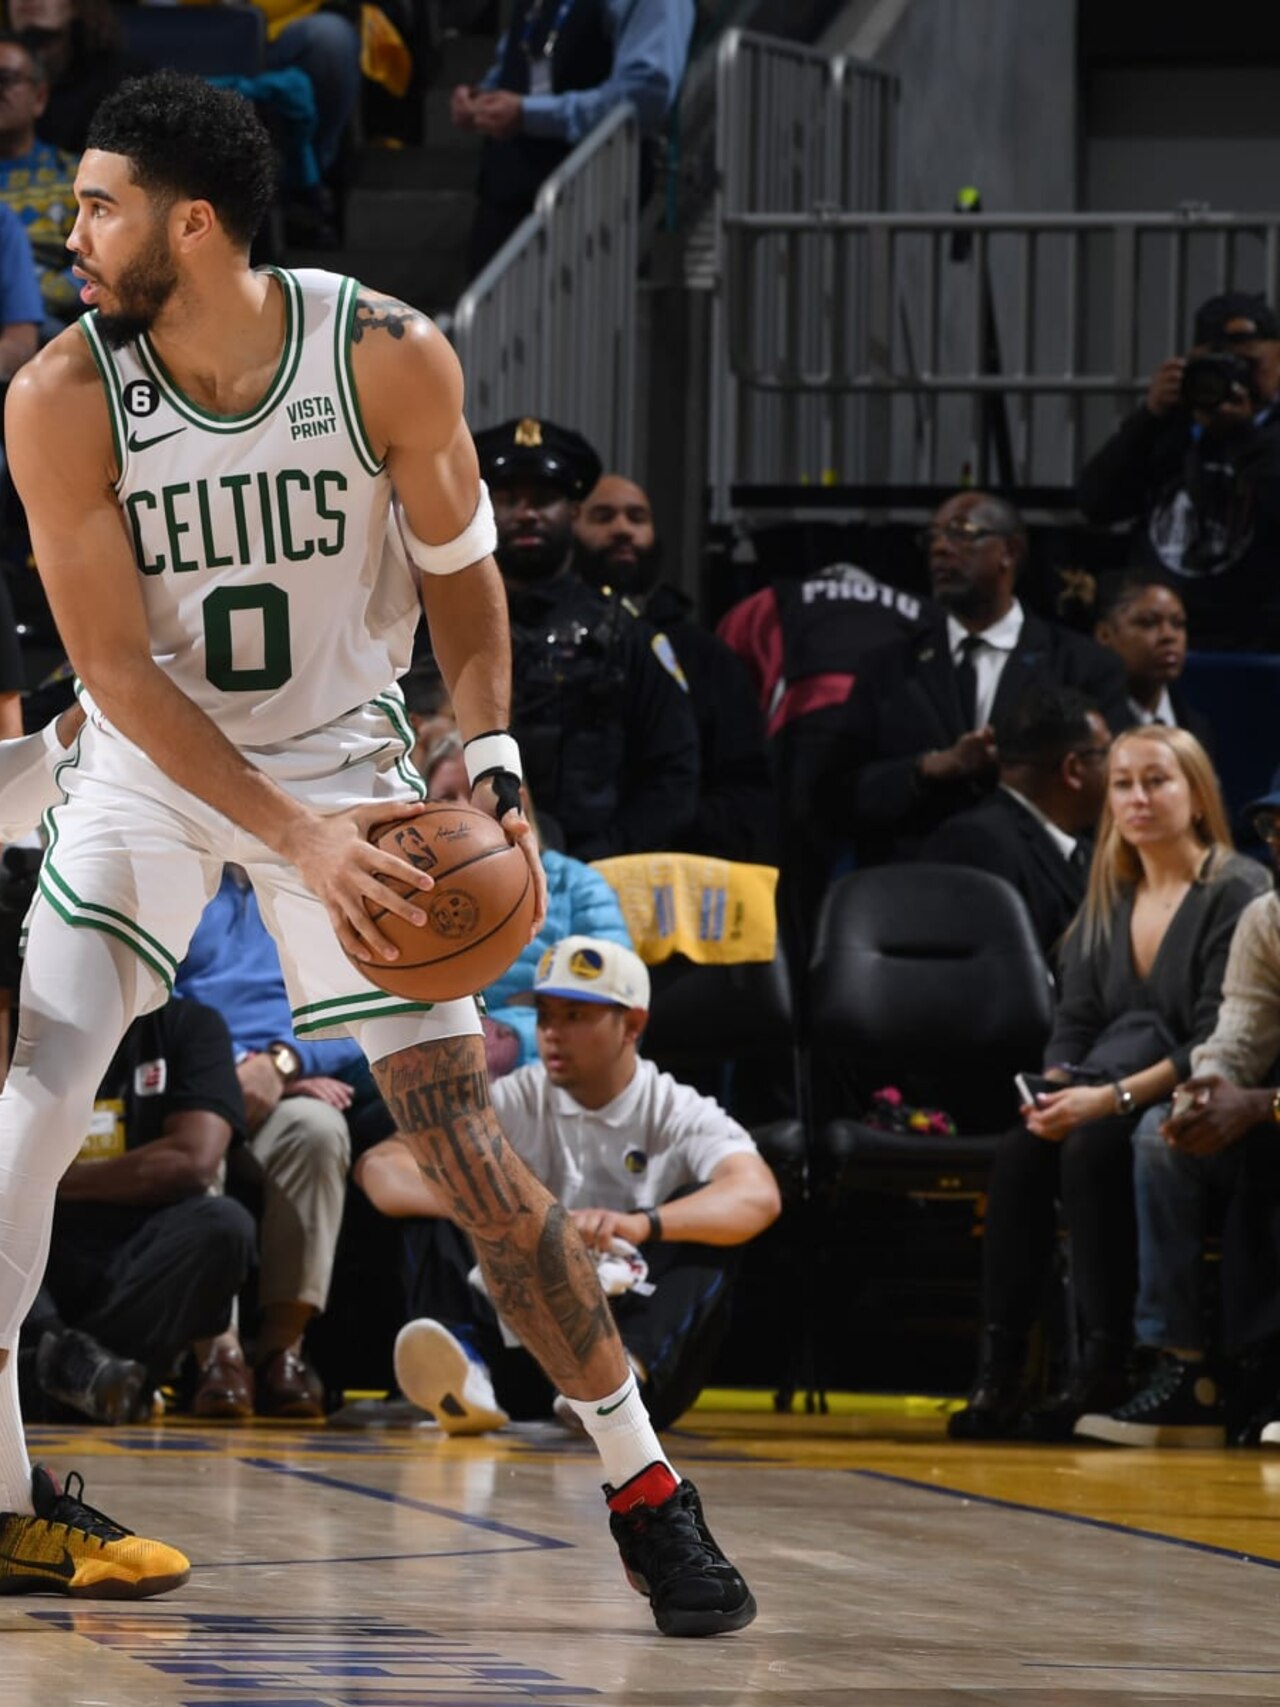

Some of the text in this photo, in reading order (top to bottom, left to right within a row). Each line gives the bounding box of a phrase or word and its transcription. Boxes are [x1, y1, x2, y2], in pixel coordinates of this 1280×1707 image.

[131, 385, 151, 413] 6
[286, 396, 336, 424] VISTA
[290, 418, 338, 441] PRINT
[126, 469, 348, 576] CELTICS
[202, 582, 293, 692] 0
